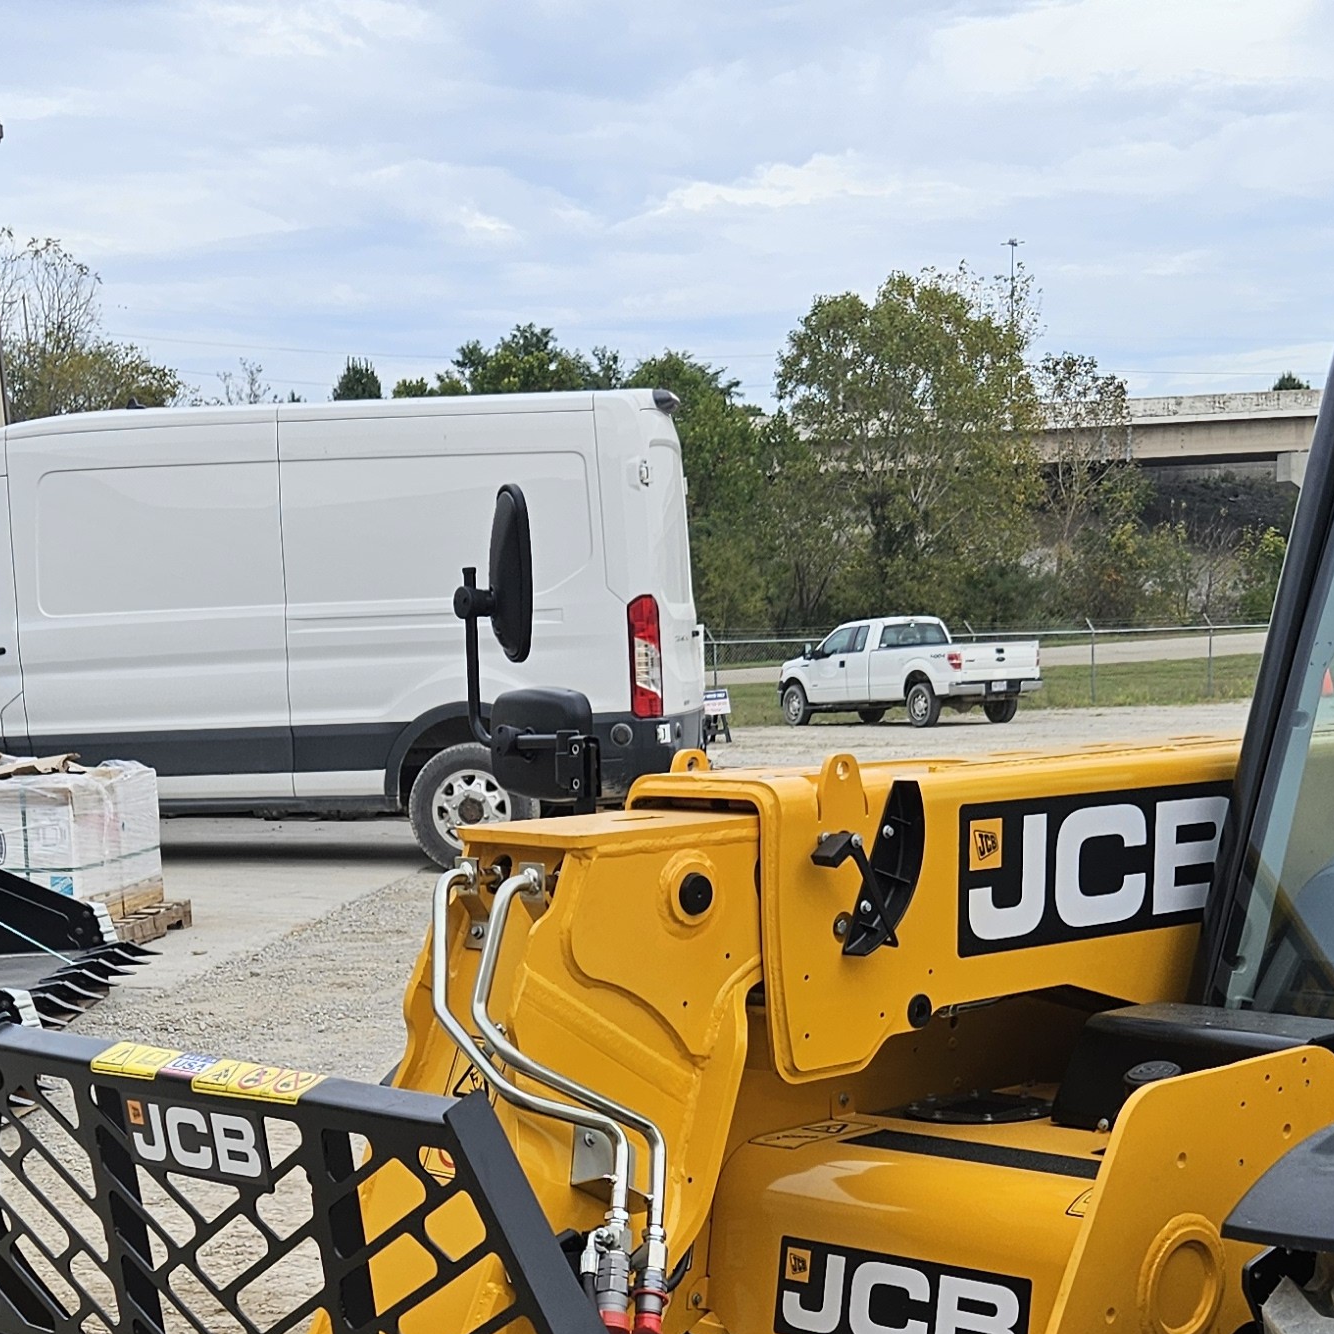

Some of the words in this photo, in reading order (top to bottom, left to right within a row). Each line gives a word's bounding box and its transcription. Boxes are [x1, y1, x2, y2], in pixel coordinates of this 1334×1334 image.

[969, 796, 1230, 940] JCB
[976, 832, 998, 859] JCB
[172, 1060, 207, 1071] USA
[132, 1103, 262, 1178] JCB
